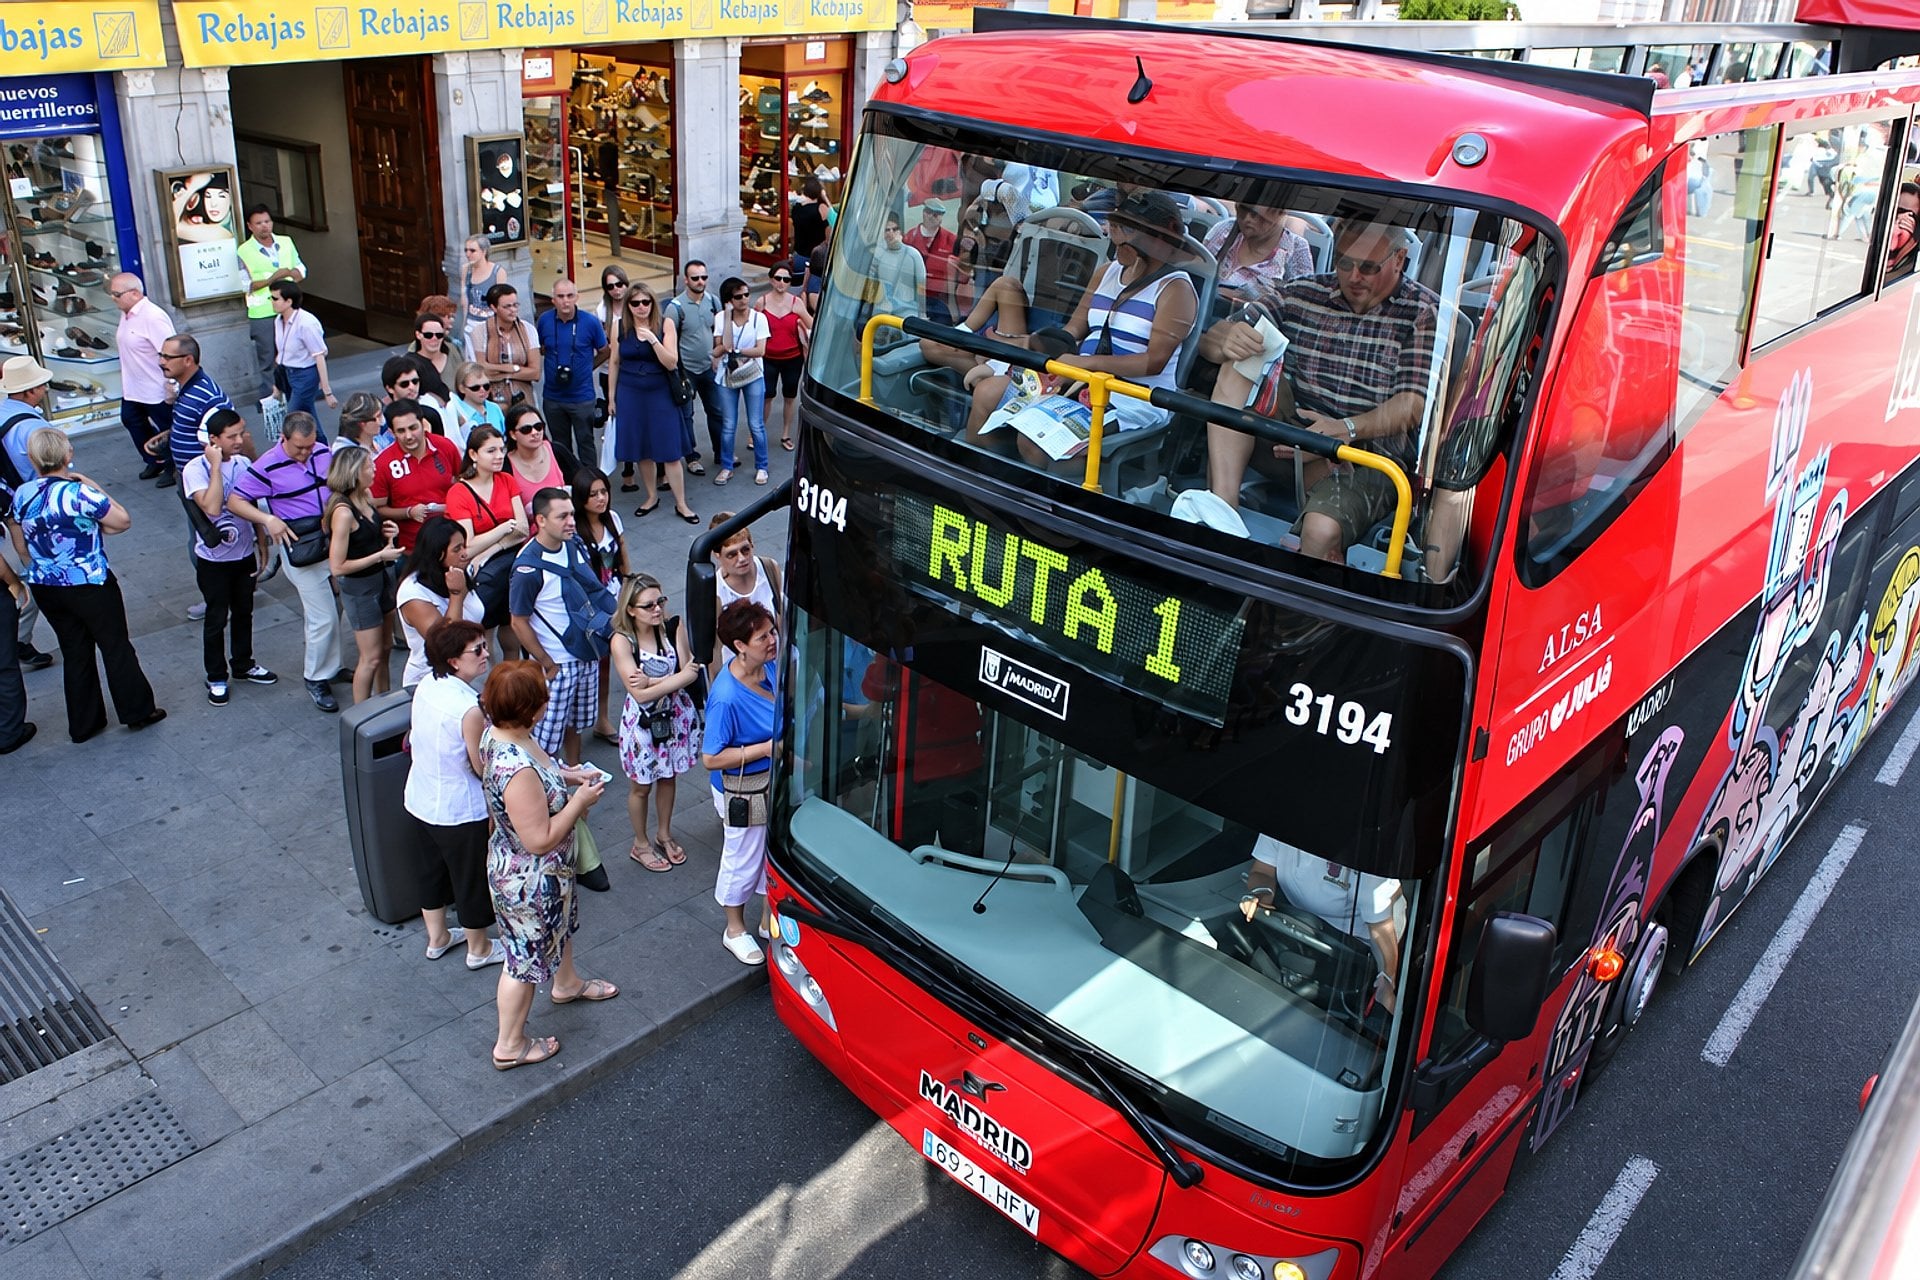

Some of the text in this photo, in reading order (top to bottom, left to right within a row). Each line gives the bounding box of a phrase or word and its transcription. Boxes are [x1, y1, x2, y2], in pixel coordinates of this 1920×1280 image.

[198, 0, 864, 52] Rebajas Rebajas Rebajas Rebajas Rebajas Rebajas
[388, 458, 411, 479] 81
[797, 477, 847, 532] 3194
[929, 504, 1181, 683] RUTA 1
[1537, 603, 1603, 674] ALSA
[1285, 682, 1393, 754] 3194
[1506, 709, 1549, 767] GRUPO
[919, 1069, 1033, 1170] MADRID
[936, 1142, 986, 1194] 6921
[996, 1184, 1035, 1228] HFV
